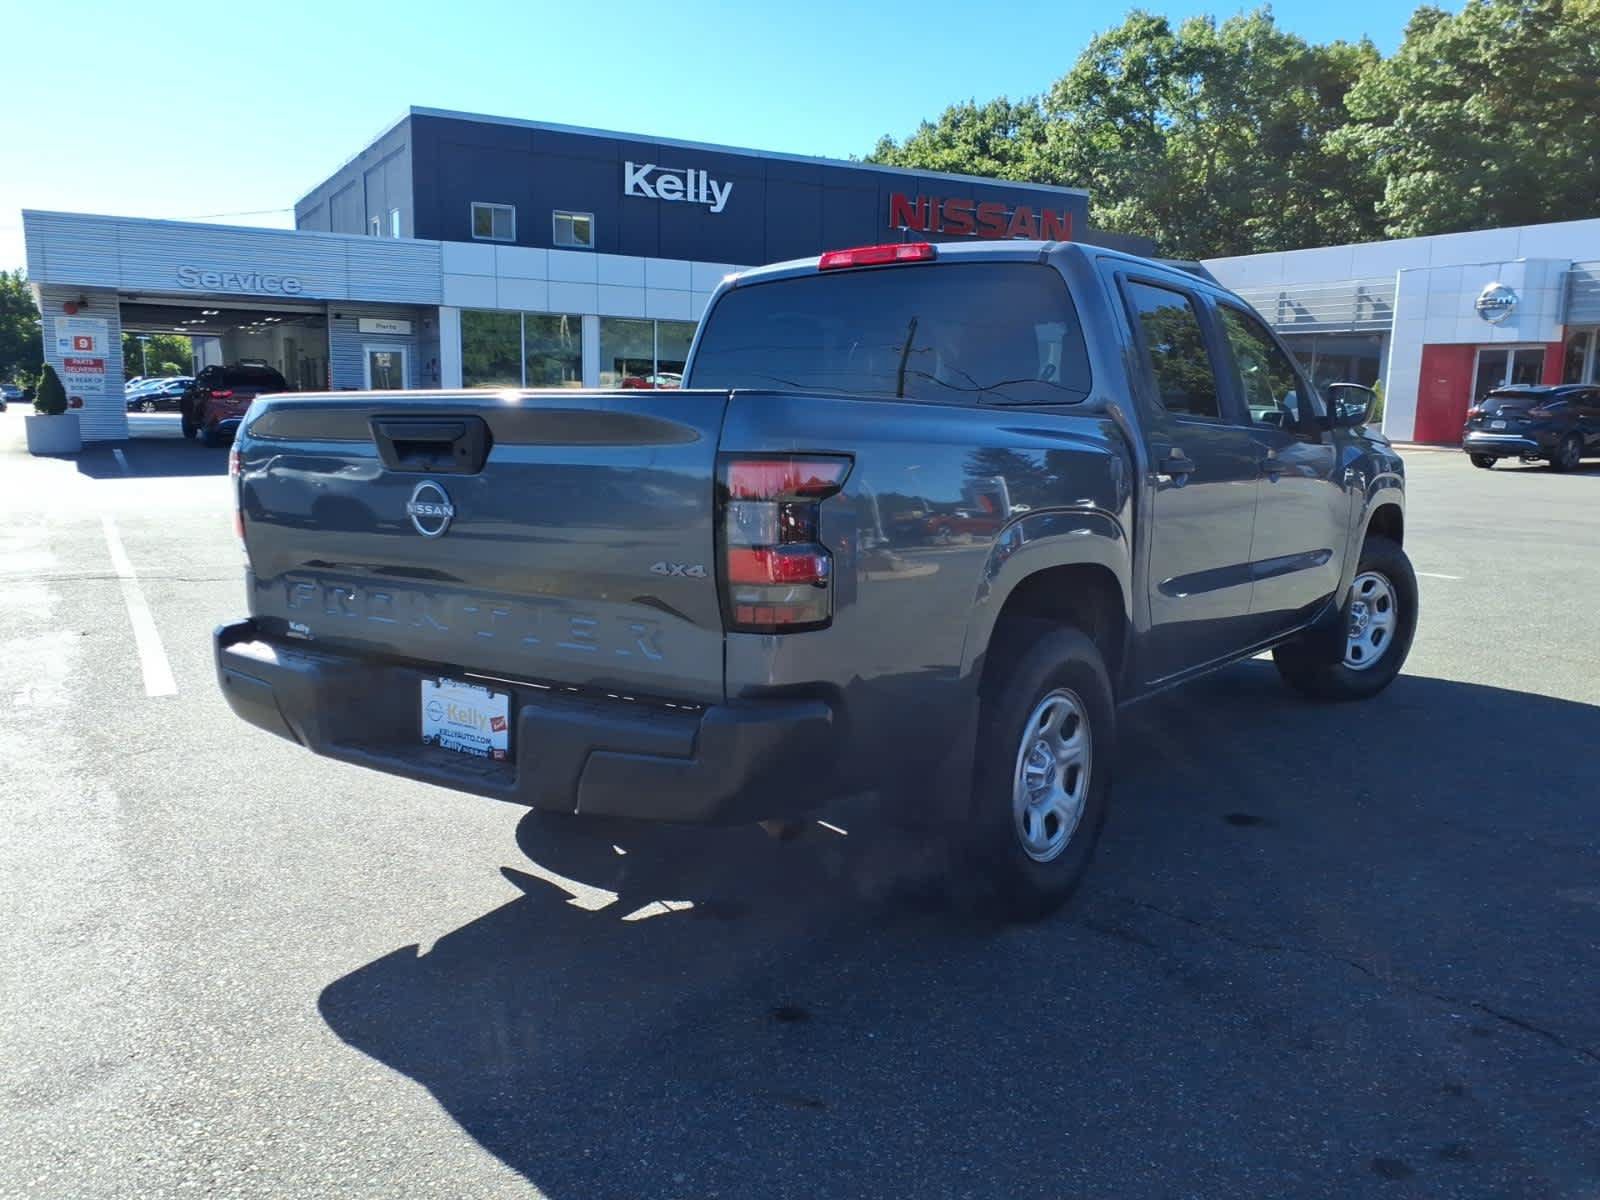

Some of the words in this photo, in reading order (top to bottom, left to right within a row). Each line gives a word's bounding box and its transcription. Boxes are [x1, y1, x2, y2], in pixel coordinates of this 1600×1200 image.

[624, 161, 733, 213] Kelly
[890, 191, 1073, 242] NISSAN
[177, 265, 302, 295] Service
[78, 338, 89, 349] 9
[407, 503, 454, 517] NISSAN
[286, 581, 664, 661] FRONTIER
[447, 703, 488, 734] Kelly
